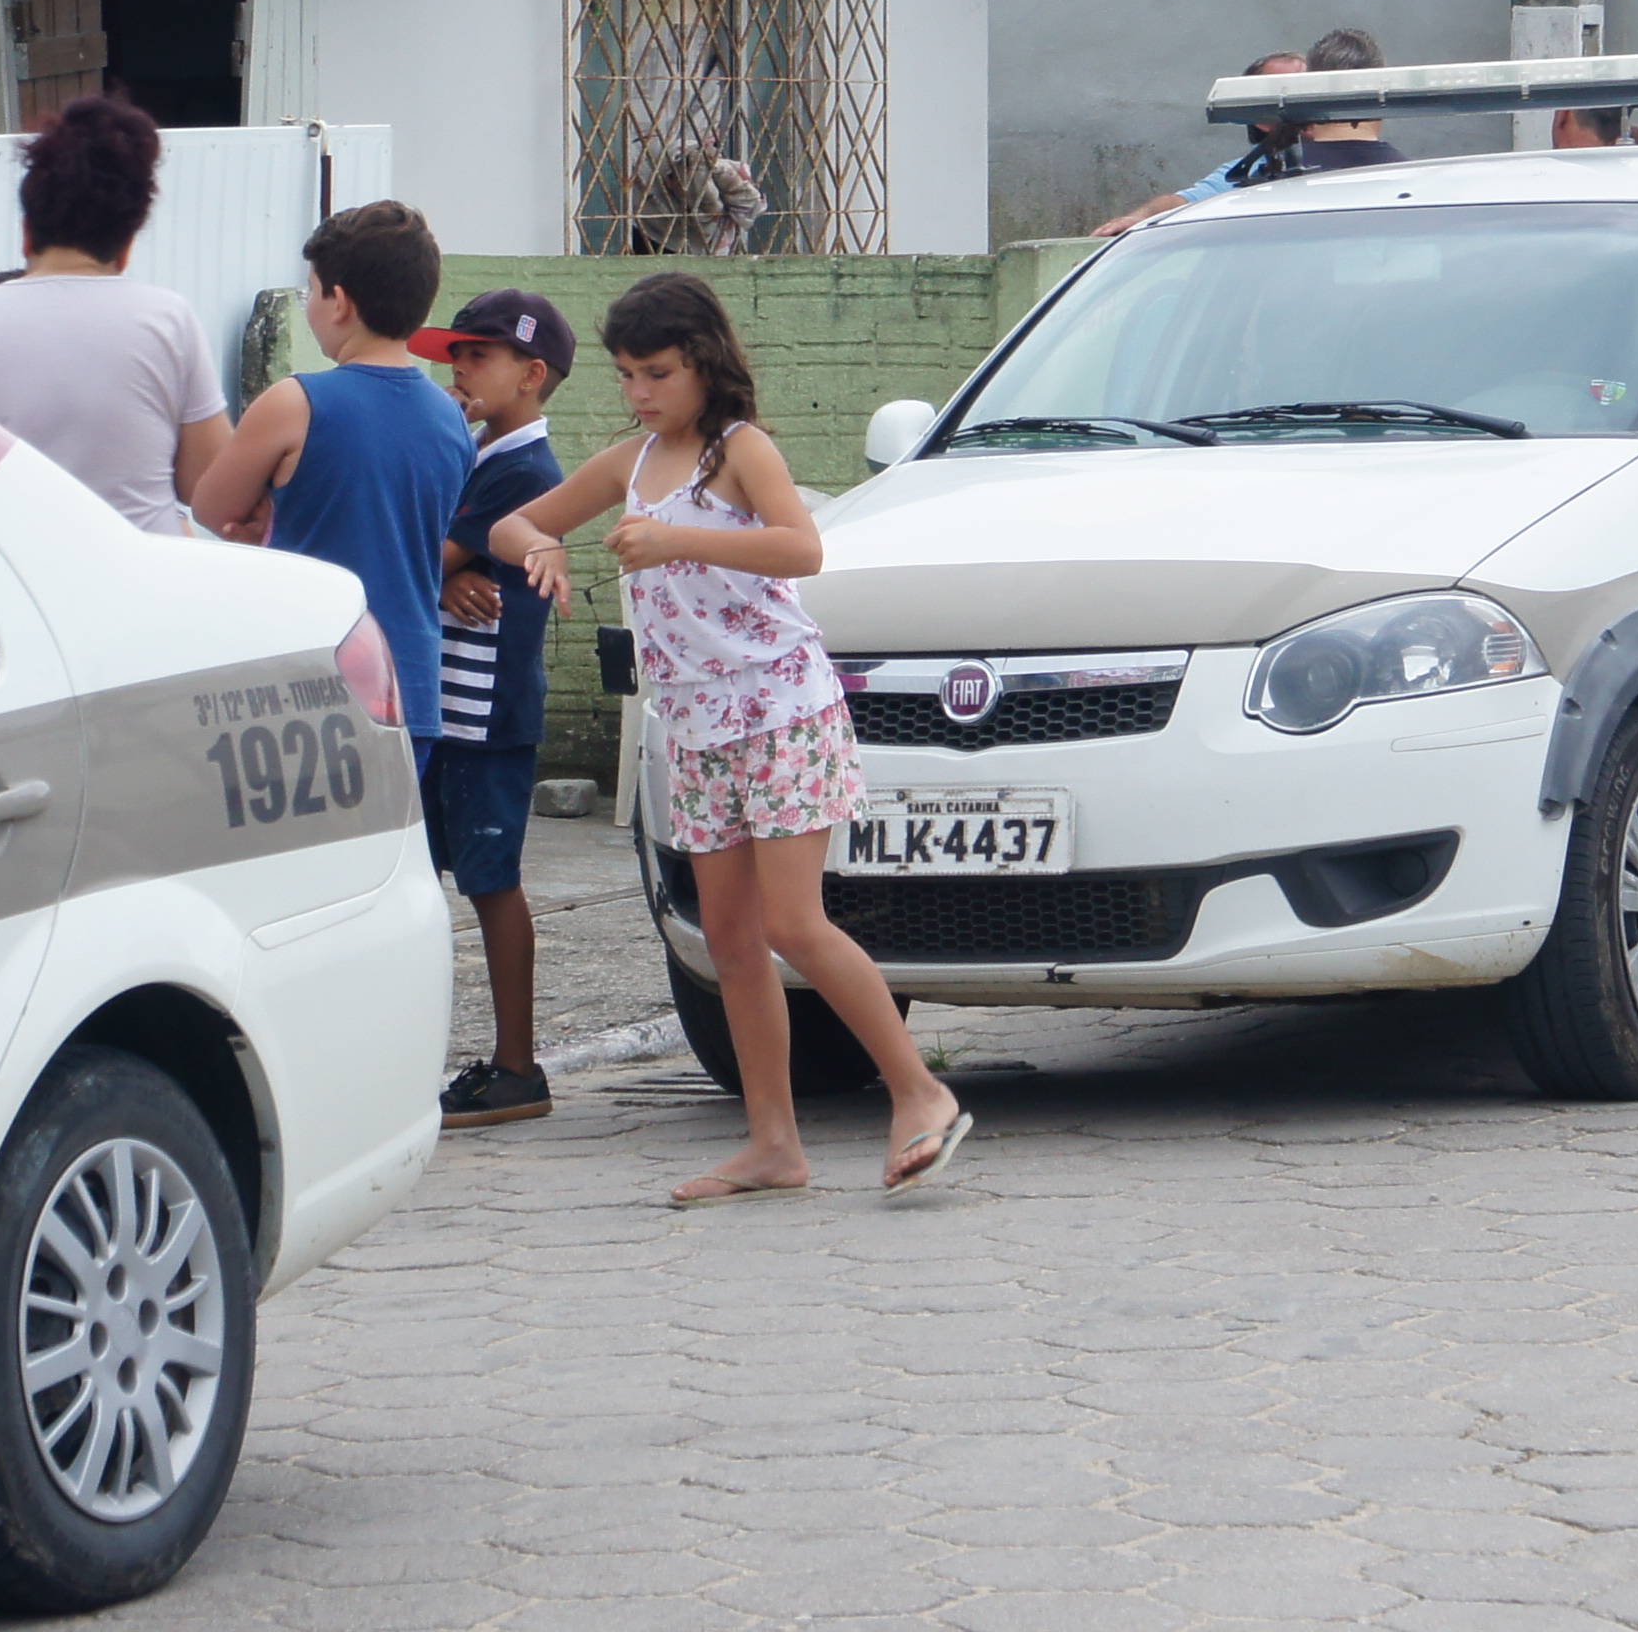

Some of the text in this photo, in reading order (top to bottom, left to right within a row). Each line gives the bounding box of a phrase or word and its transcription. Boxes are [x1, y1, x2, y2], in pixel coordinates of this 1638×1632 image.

[244, 684, 283, 719] BPM
[287, 675, 350, 712] TIJUCAS
[952, 679, 984, 706] FIAT
[206, 713, 365, 828] 1926
[907, 801, 1001, 814] SANTA CATARINA
